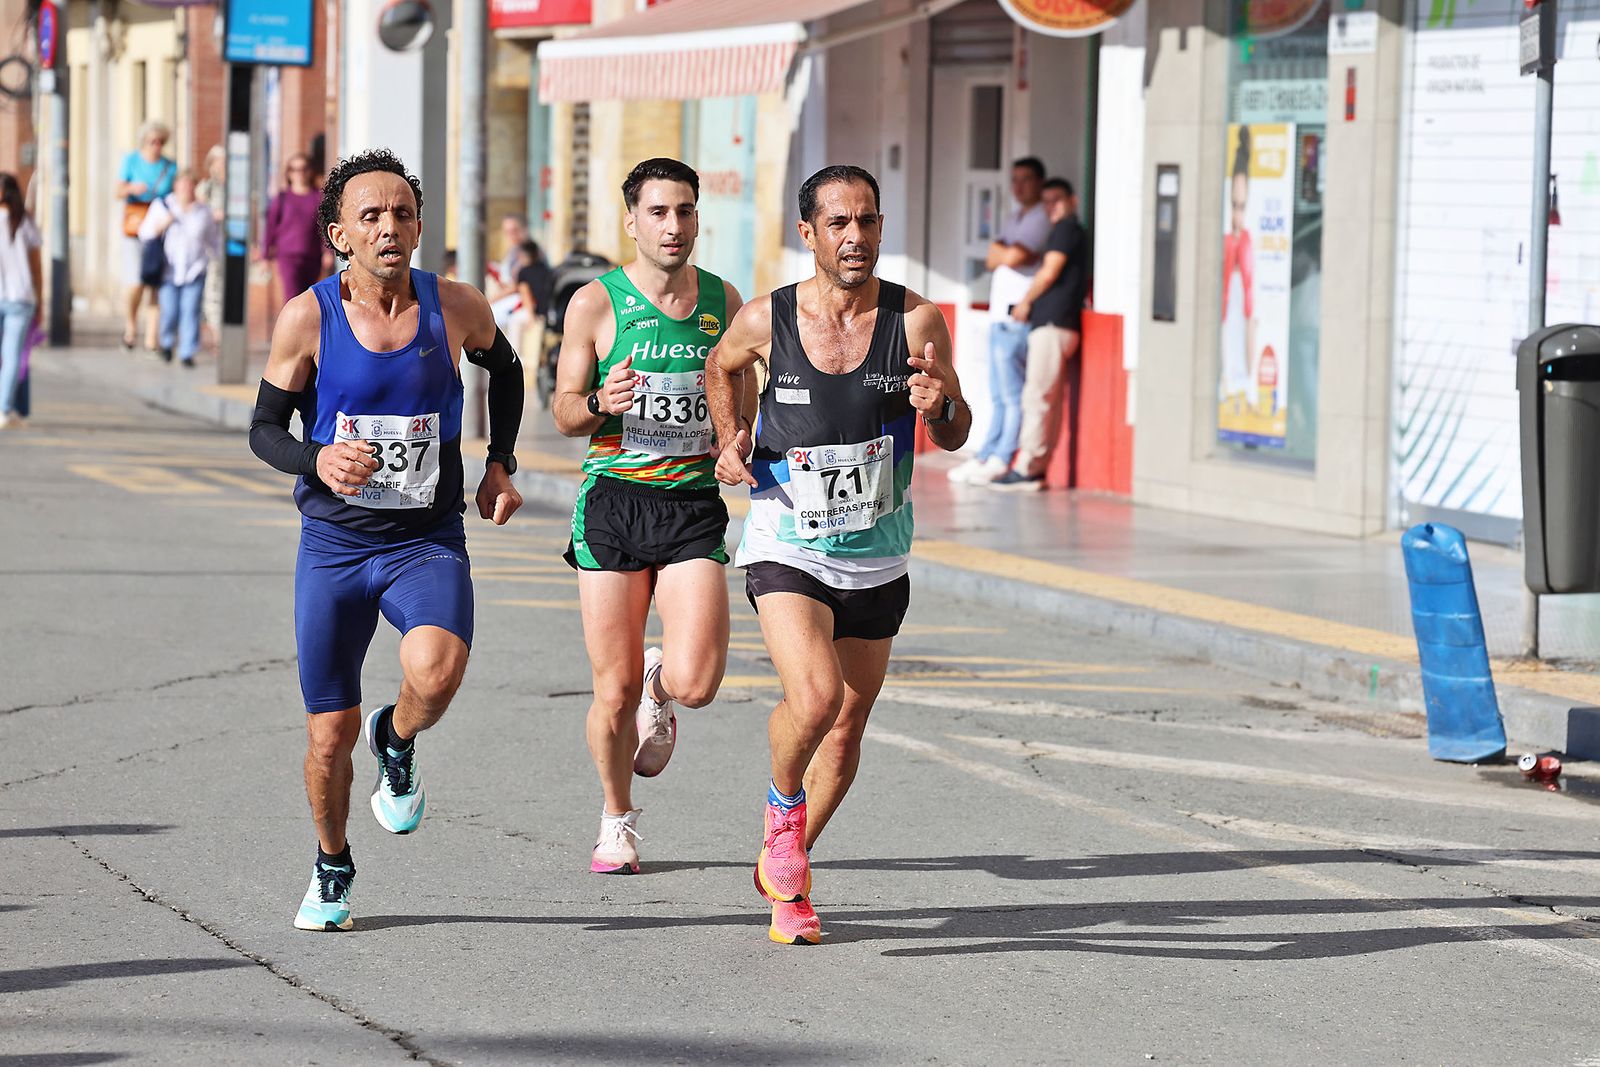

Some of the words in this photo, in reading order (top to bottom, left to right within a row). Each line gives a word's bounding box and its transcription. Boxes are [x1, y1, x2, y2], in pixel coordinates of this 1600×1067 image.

[620, 304, 645, 315] VIATOR
[631, 341, 715, 361] Huesc
[633, 393, 708, 424] 1336
[625, 426, 684, 439] ABELLANEDA
[685, 428, 709, 439] LOPEZ
[627, 432, 667, 448] Huelva
[801, 504, 858, 518] CONTRERAS
[801, 515, 846, 530] Helva
